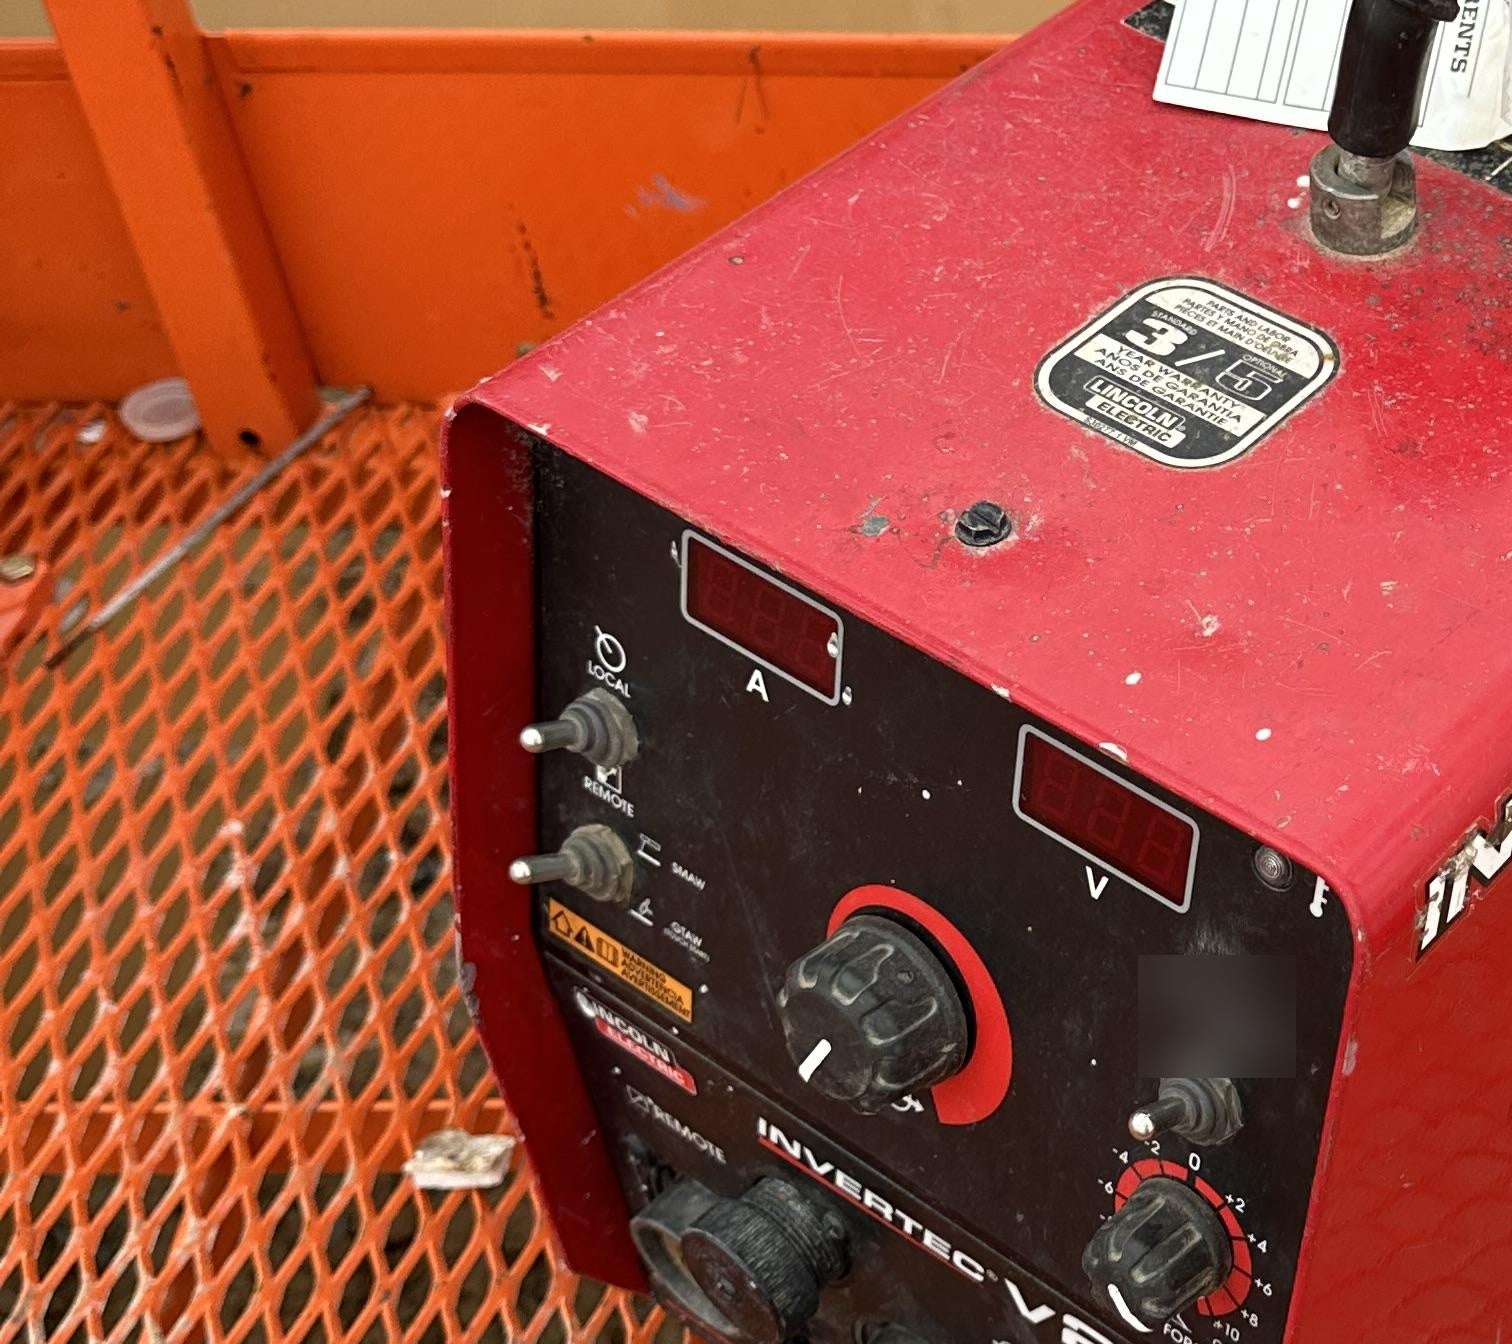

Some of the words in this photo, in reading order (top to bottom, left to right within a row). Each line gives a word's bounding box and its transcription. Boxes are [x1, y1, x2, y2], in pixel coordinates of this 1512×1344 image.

[1151, 310, 1198, 336] STANDARD
[1182, 298, 1217, 317] PARTES
[1217, 313, 1225, 321] Y
[1225, 317, 1257, 337] MANO
[1256, 333, 1270, 344] DE
[1205, 319, 1218, 328] ET
[1217, 324, 1246, 342] MAIN
[1206, 300, 1236, 317] PARTS
[1235, 314, 1258, 328] AND
[1258, 324, 1292, 343] LABOR
[1117, 345, 1156, 369] YEAR
[1157, 365, 1242, 409] WARRANTY
[1242, 354, 1288, 378] OPTIONAL
[1090, 379, 1179, 429] LINCOLN
[1094, 358, 1128, 377] ANS
[1128, 374, 1150, 388] DE
[1151, 385, 1229, 426] GARANTIE
[1142, 369, 1164, 384] DE
[1165, 380, 1242, 424] GARANTIA
[1096, 400, 1173, 443] ELECTRIC
[587, 660, 631, 698] LOCAL
[746, 668, 770, 702] A
[583, 775, 635, 818] REMOTE
[672, 861, 706, 891] SMAW
[1086, 865, 1110, 900] V
[621, 946, 667, 984] WARNING
[586, 999, 671, 1063] INCOLN
[1188, 1152, 1201, 1171] 0
[1225, 1193, 1246, 1213] +2
[1247, 1233, 1267, 1253] +4
[1254, 1278, 1273, 1297] +6
[1213, 1320, 1241, 1343] +10
[1240, 1309, 1259, 1328] +8
